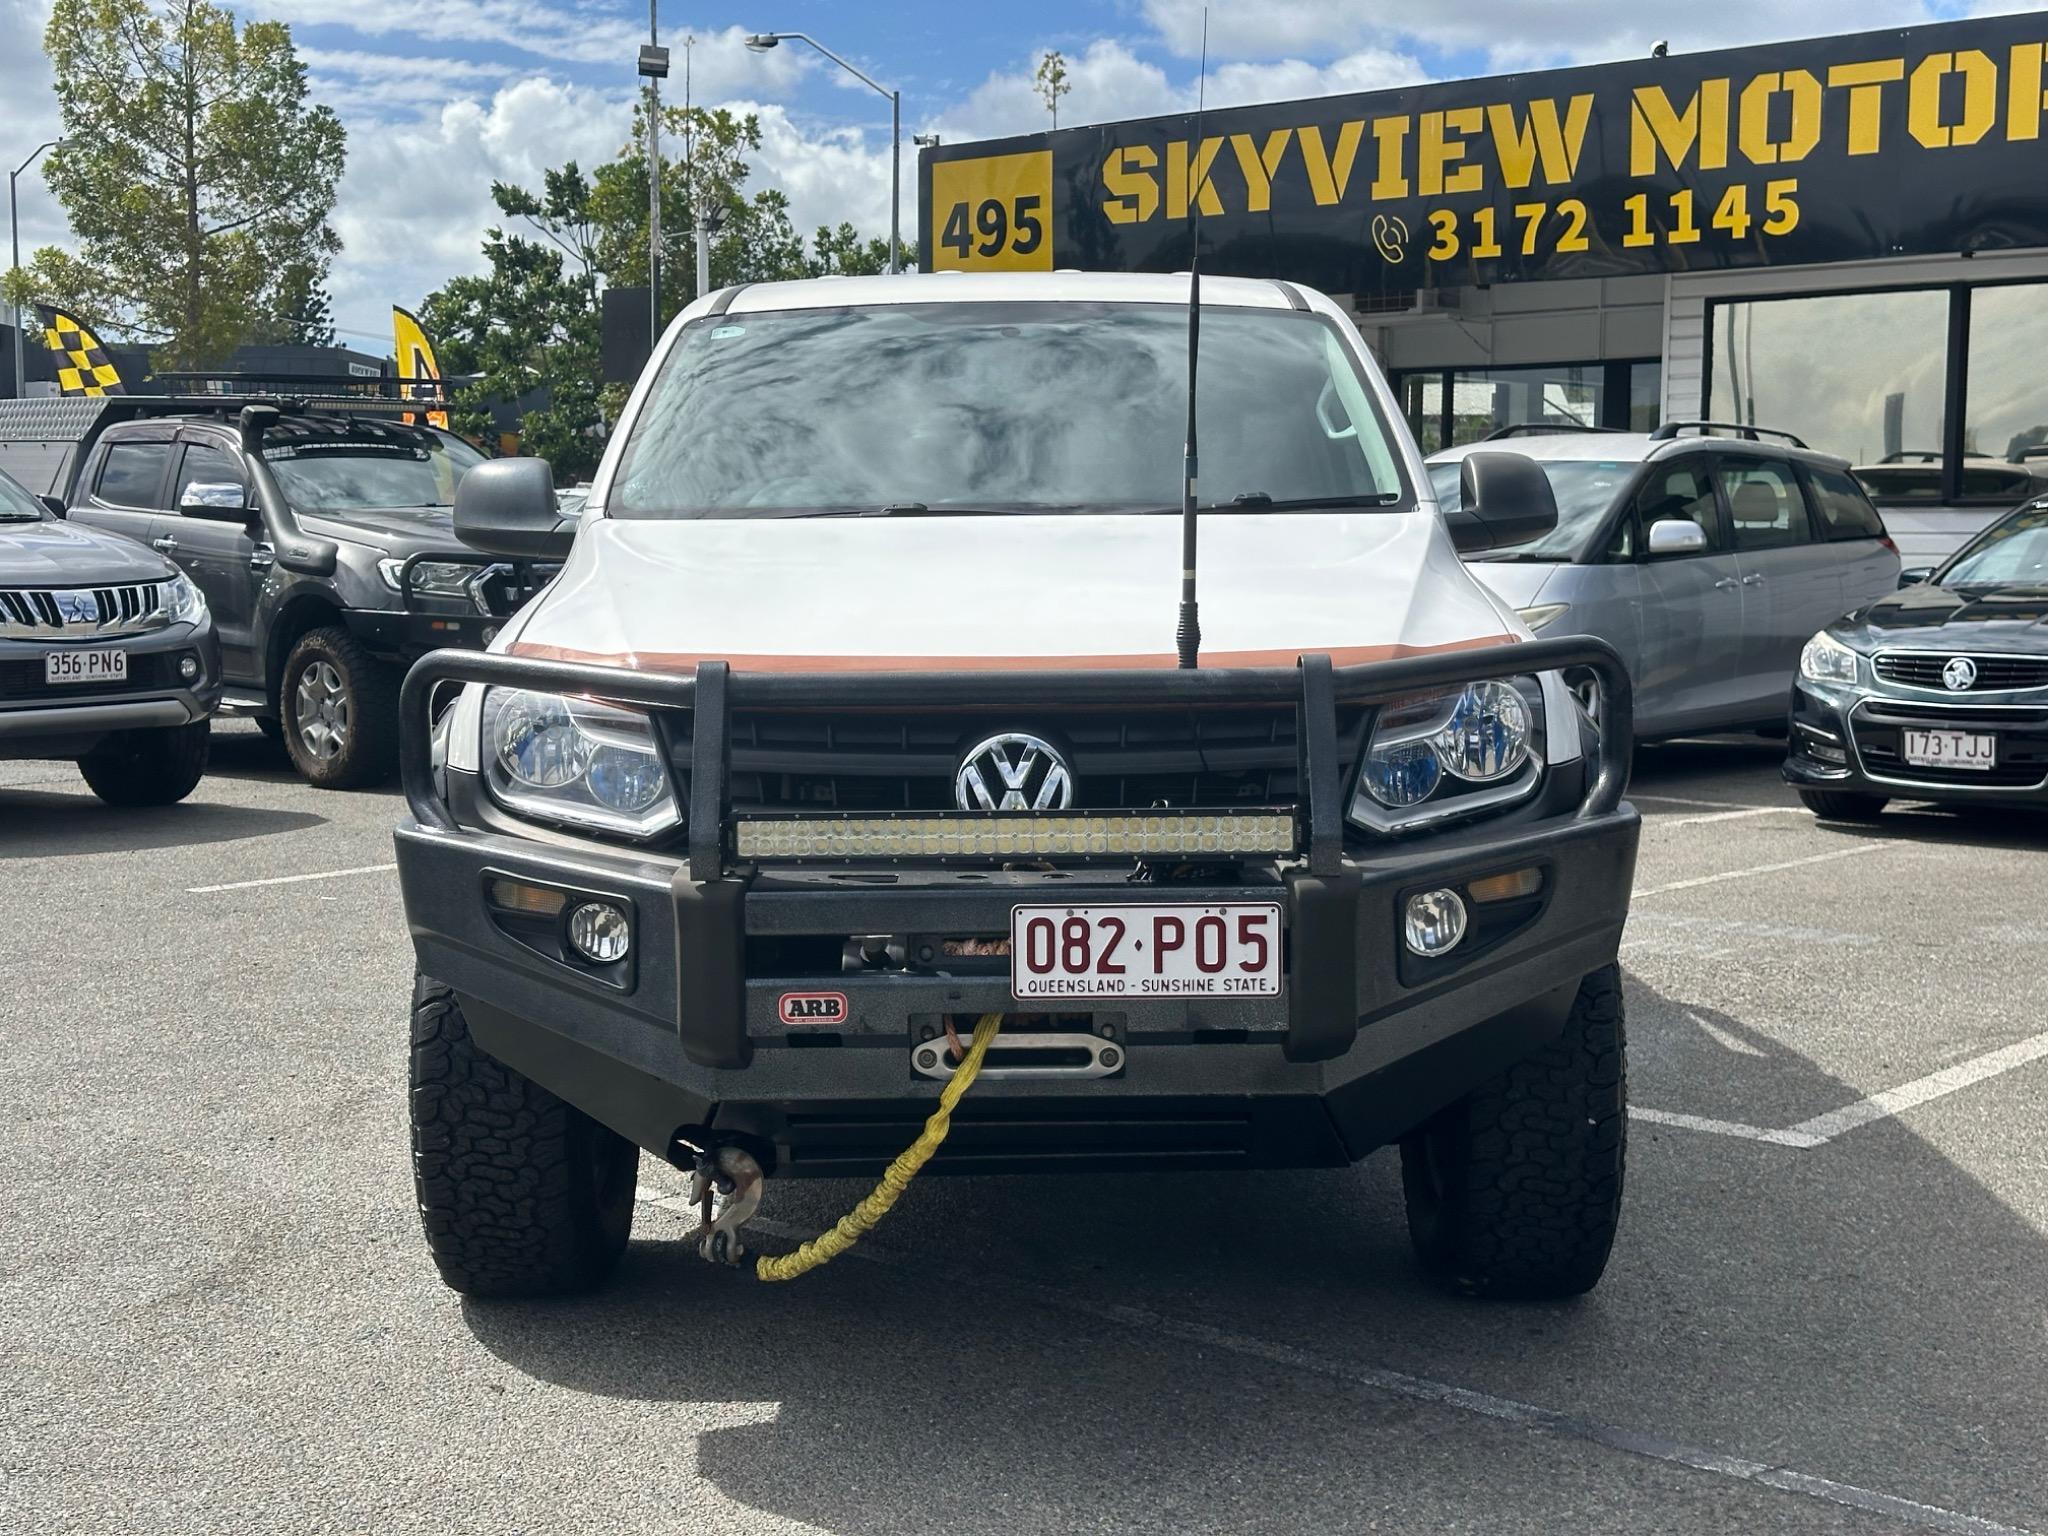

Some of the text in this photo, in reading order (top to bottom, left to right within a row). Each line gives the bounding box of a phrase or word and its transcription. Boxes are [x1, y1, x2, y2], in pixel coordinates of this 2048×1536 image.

[1102, 93, 1595, 225] SKYVIEW
[941, 195, 1043, 260] 495
[1427, 178, 1801, 261] 3172 1145
[787, 999, 841, 1018] ARB
[1028, 979, 1126, 993] QUEENSLAND
[1141, 978, 1215, 992] SUNSHINE
[1223, 978, 1268, 992] STATE
